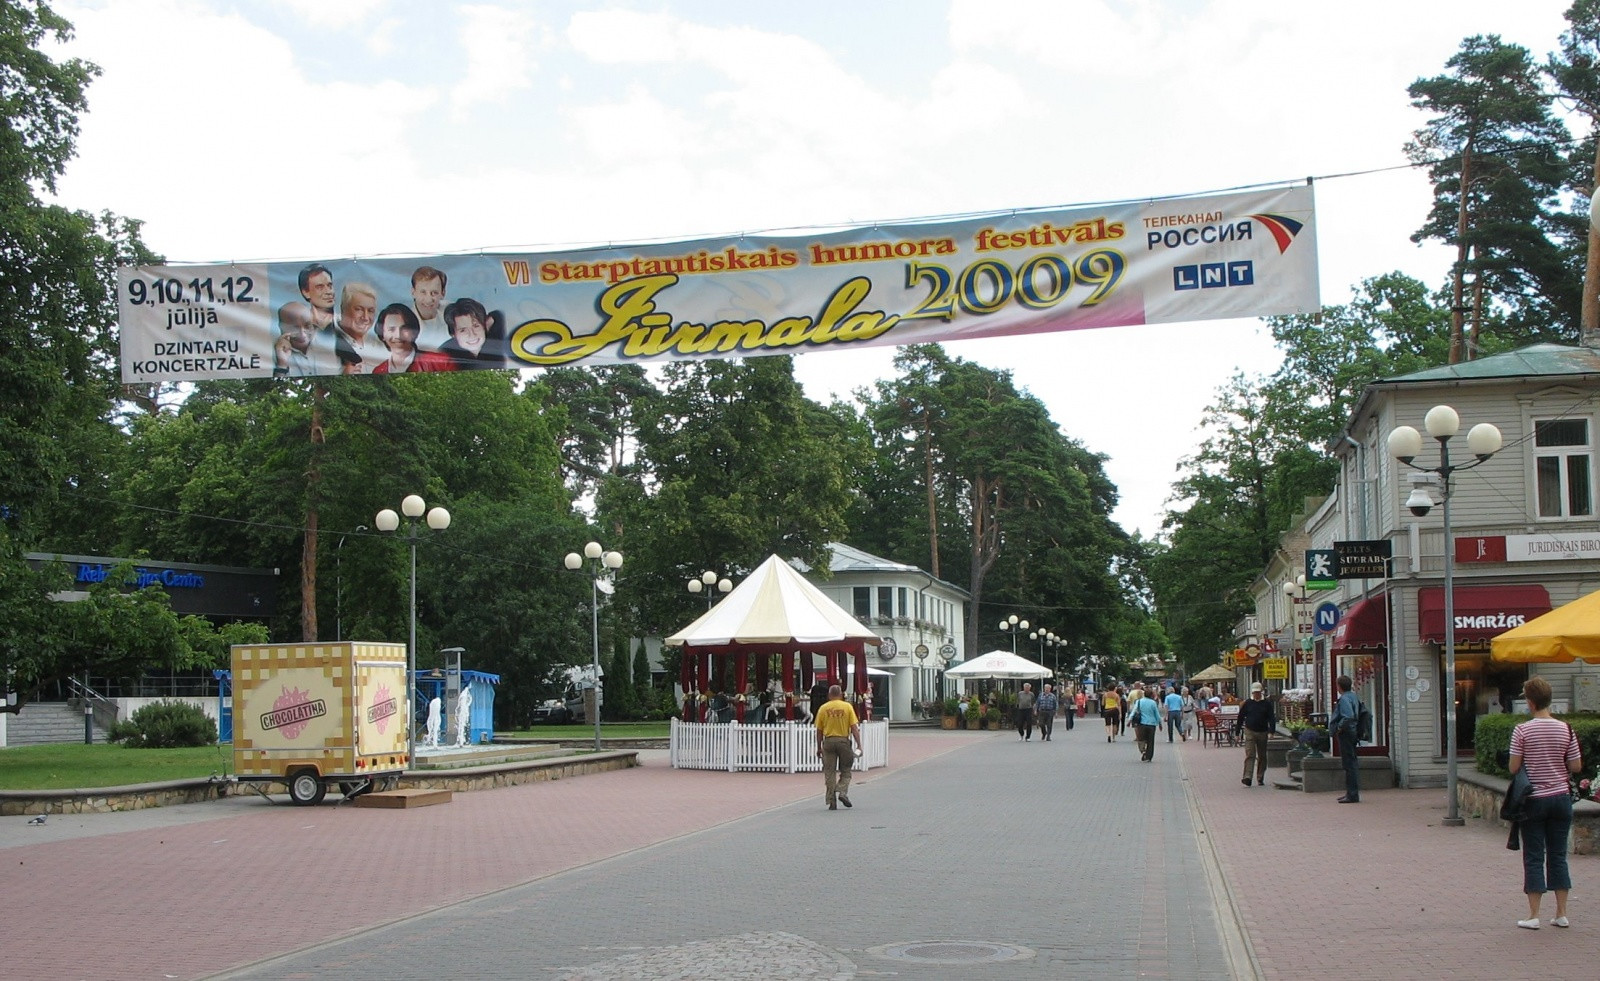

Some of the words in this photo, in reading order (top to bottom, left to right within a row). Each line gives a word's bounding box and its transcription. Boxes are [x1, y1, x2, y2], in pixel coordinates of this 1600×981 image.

[1143, 211, 1223, 229] ТЕЛЕКАНАЛ
[1147, 221, 1253, 250] РОССИЯ
[503, 260, 530, 286] VI
[540, 247, 798, 284] Starptautiskais
[810, 238, 957, 265] humora
[975, 217, 1125, 252] festivāls
[1177, 265, 1249, 287] LNT
[166, 306, 219, 330] jūlijā
[508, 272, 900, 367] Jūrmala
[902, 248, 1129, 322] 2009
[154, 339, 240, 356] DZINTARU
[132, 353, 261, 375] KONCERTZĀLĒ
[1320, 610, 1335, 625] N
[1454, 612, 1526, 629] SMARŽAS
[262, 702, 324, 728] CHOCOLATINA
